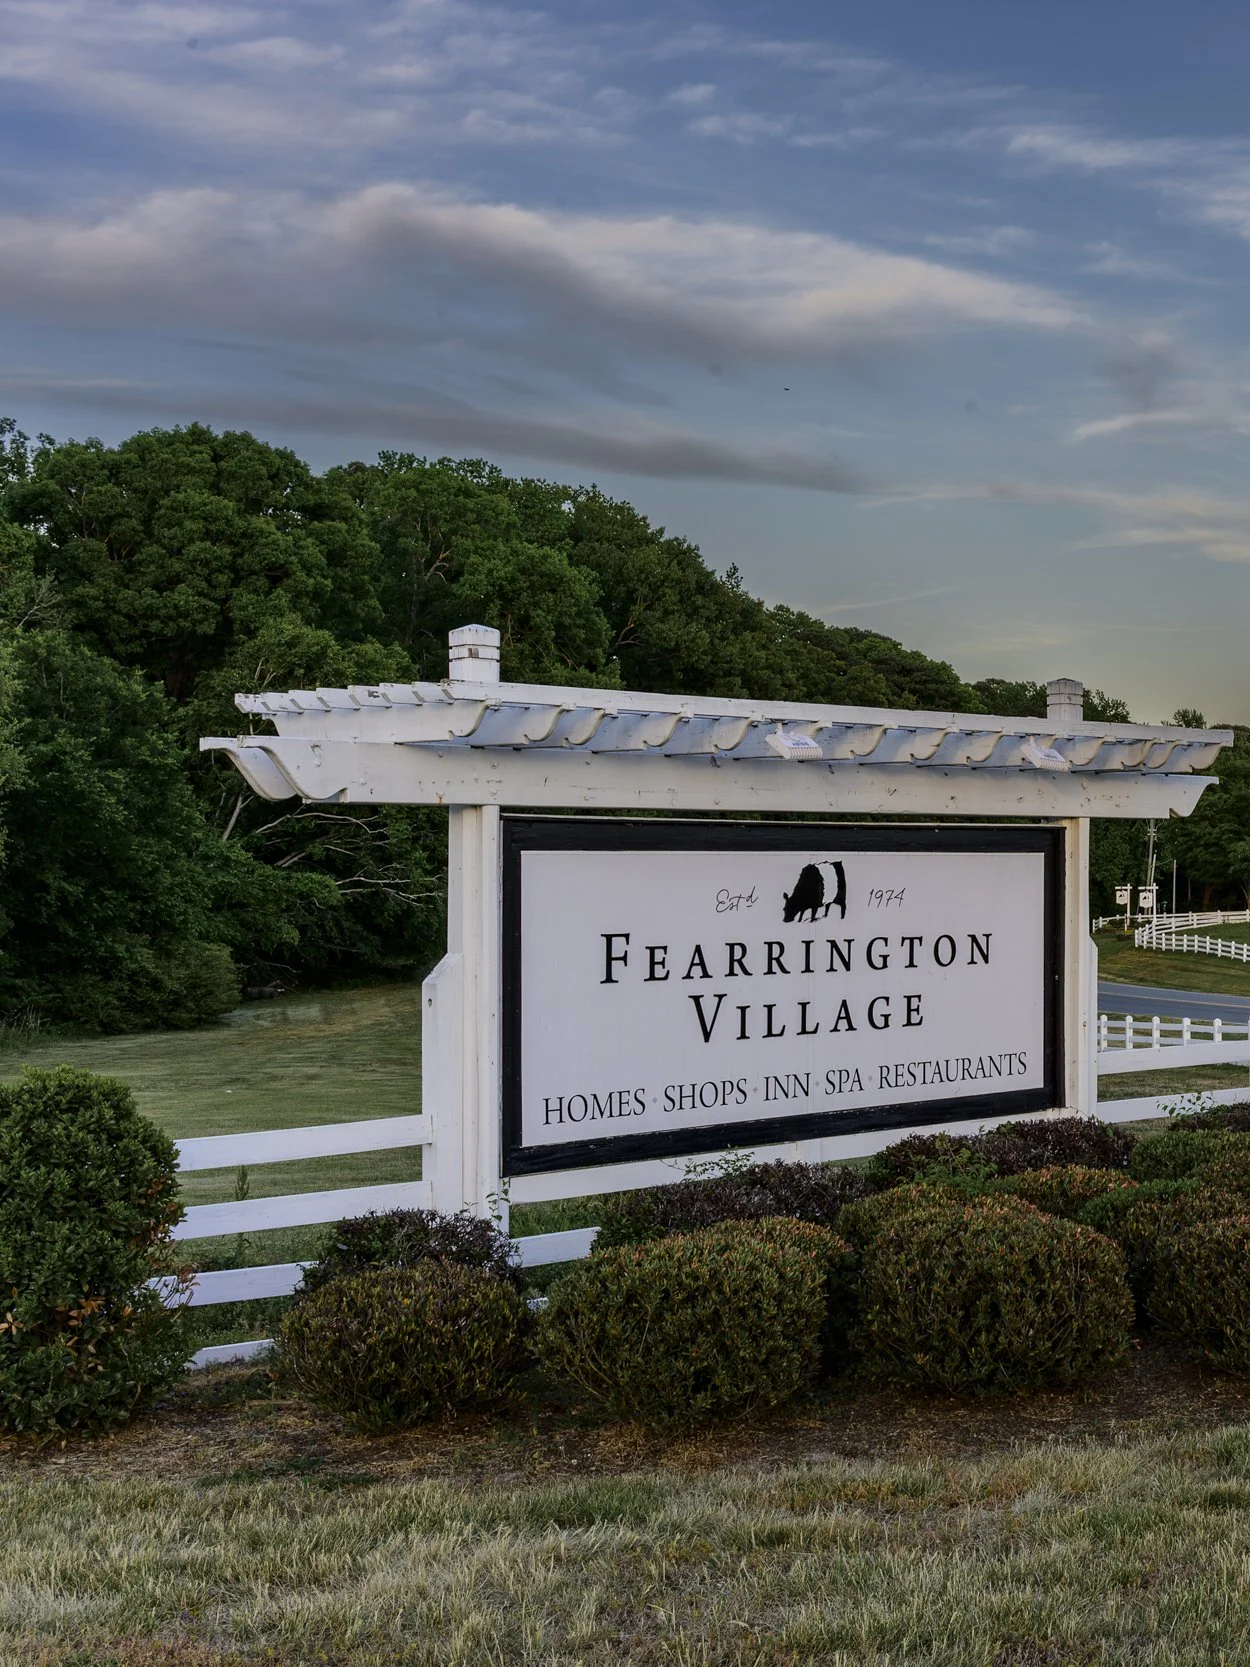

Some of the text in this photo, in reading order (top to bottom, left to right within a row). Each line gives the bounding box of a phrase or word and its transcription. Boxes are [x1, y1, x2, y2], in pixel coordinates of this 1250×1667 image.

[867, 887, 905, 908] 1974
[542, 1051, 1027, 1126] HOMES SHOPS INN SPA RESTAURANTS
